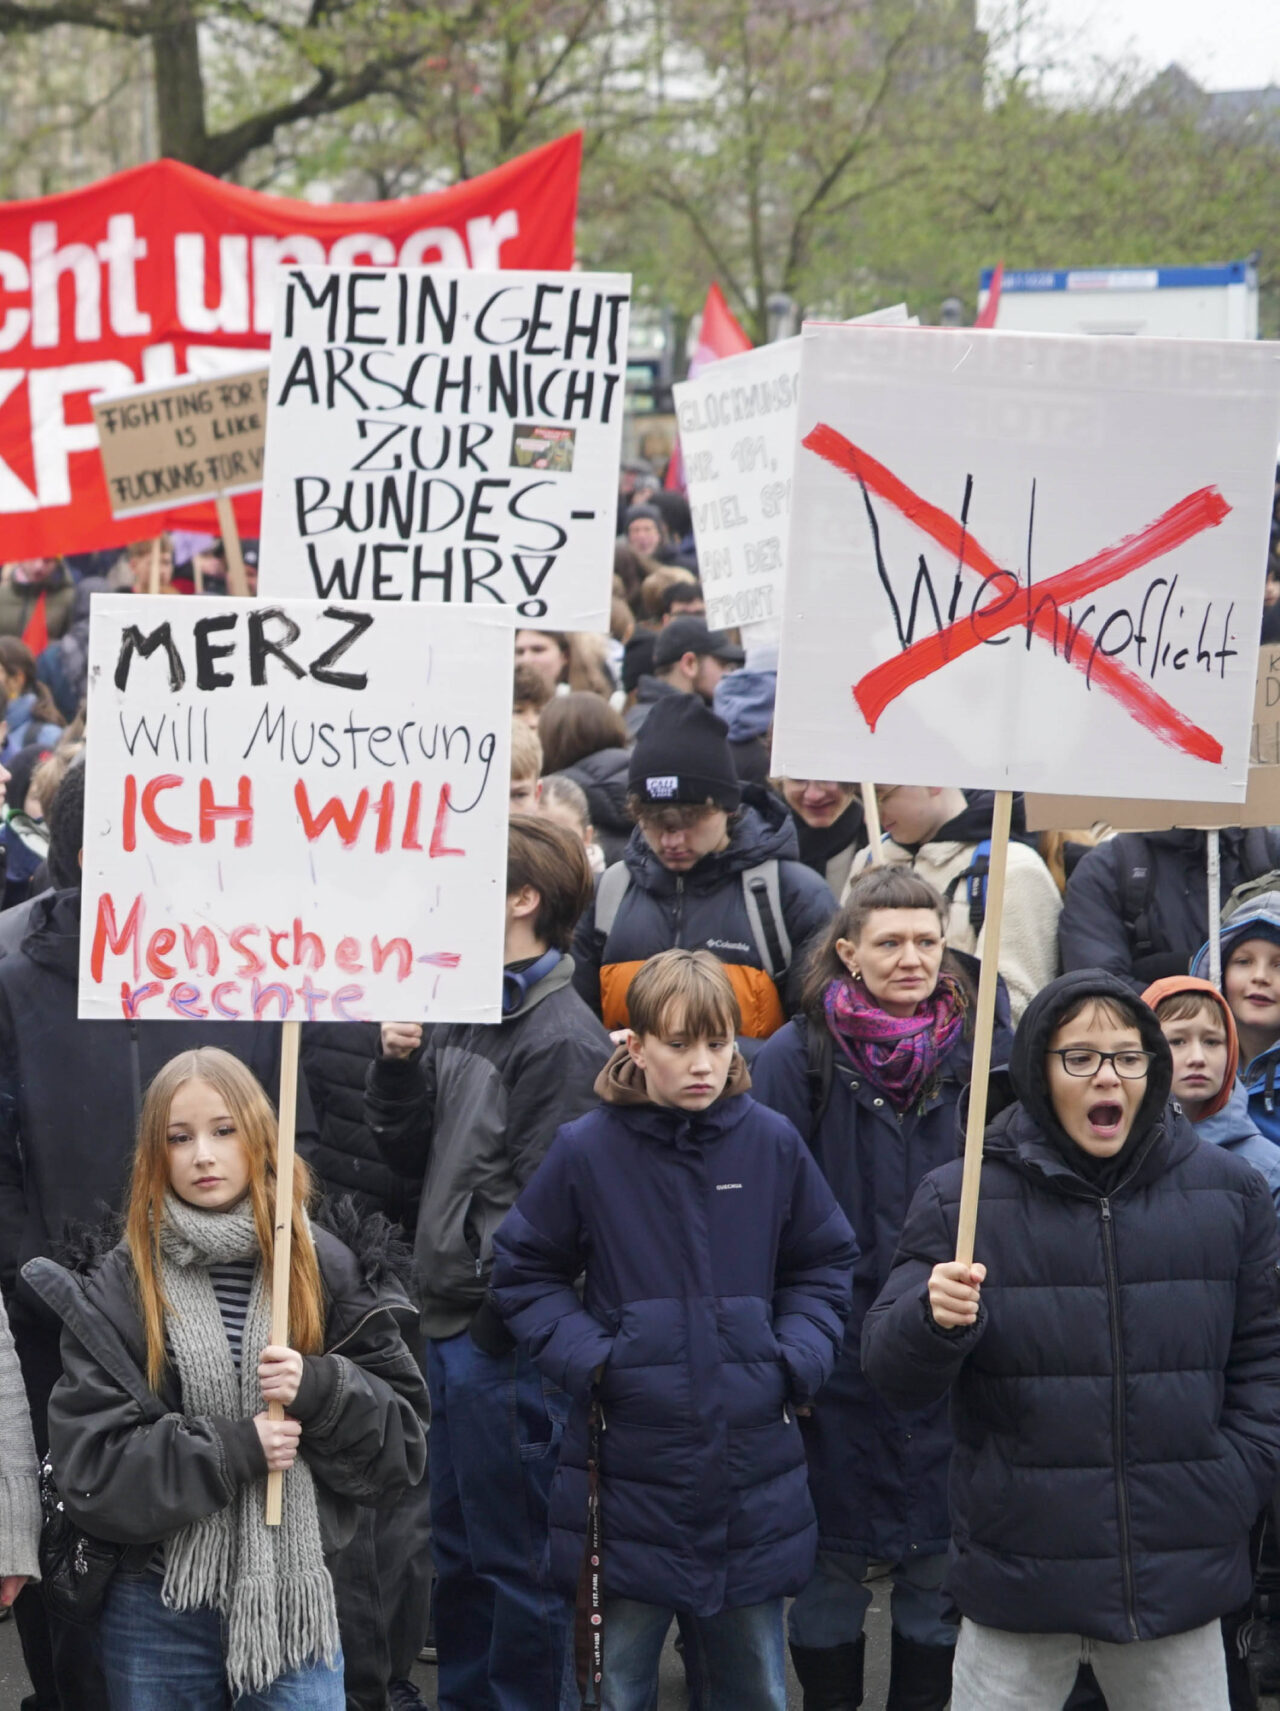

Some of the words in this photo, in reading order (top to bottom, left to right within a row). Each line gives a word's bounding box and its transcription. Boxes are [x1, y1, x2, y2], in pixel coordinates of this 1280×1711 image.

[283, 270, 458, 346] MEIN
[474, 283, 630, 365] GEHT
[100, 389, 213, 435] FIGHTING
[216, 382, 253, 408] FOR
[276, 346, 473, 414] ARSCH
[488, 350, 620, 424] NICHT
[174, 425, 197, 448] IS
[211, 412, 262, 440] LIKE
[350, 419, 494, 472] ZUR
[110, 461, 204, 502] FUCKING
[294, 470, 596, 552] BUNDES-
[306, 541, 557, 618] WEHR!
[846, 447, 1239, 692] Wehrpflicht
[114, 605, 375, 692] MERZ
[243, 702, 497, 813] Musterung
[122, 773, 254, 853] ICH
[293, 776, 467, 858] WILL
[90, 891, 462, 984] Menschen-
[120, 975, 372, 1022] rechte
